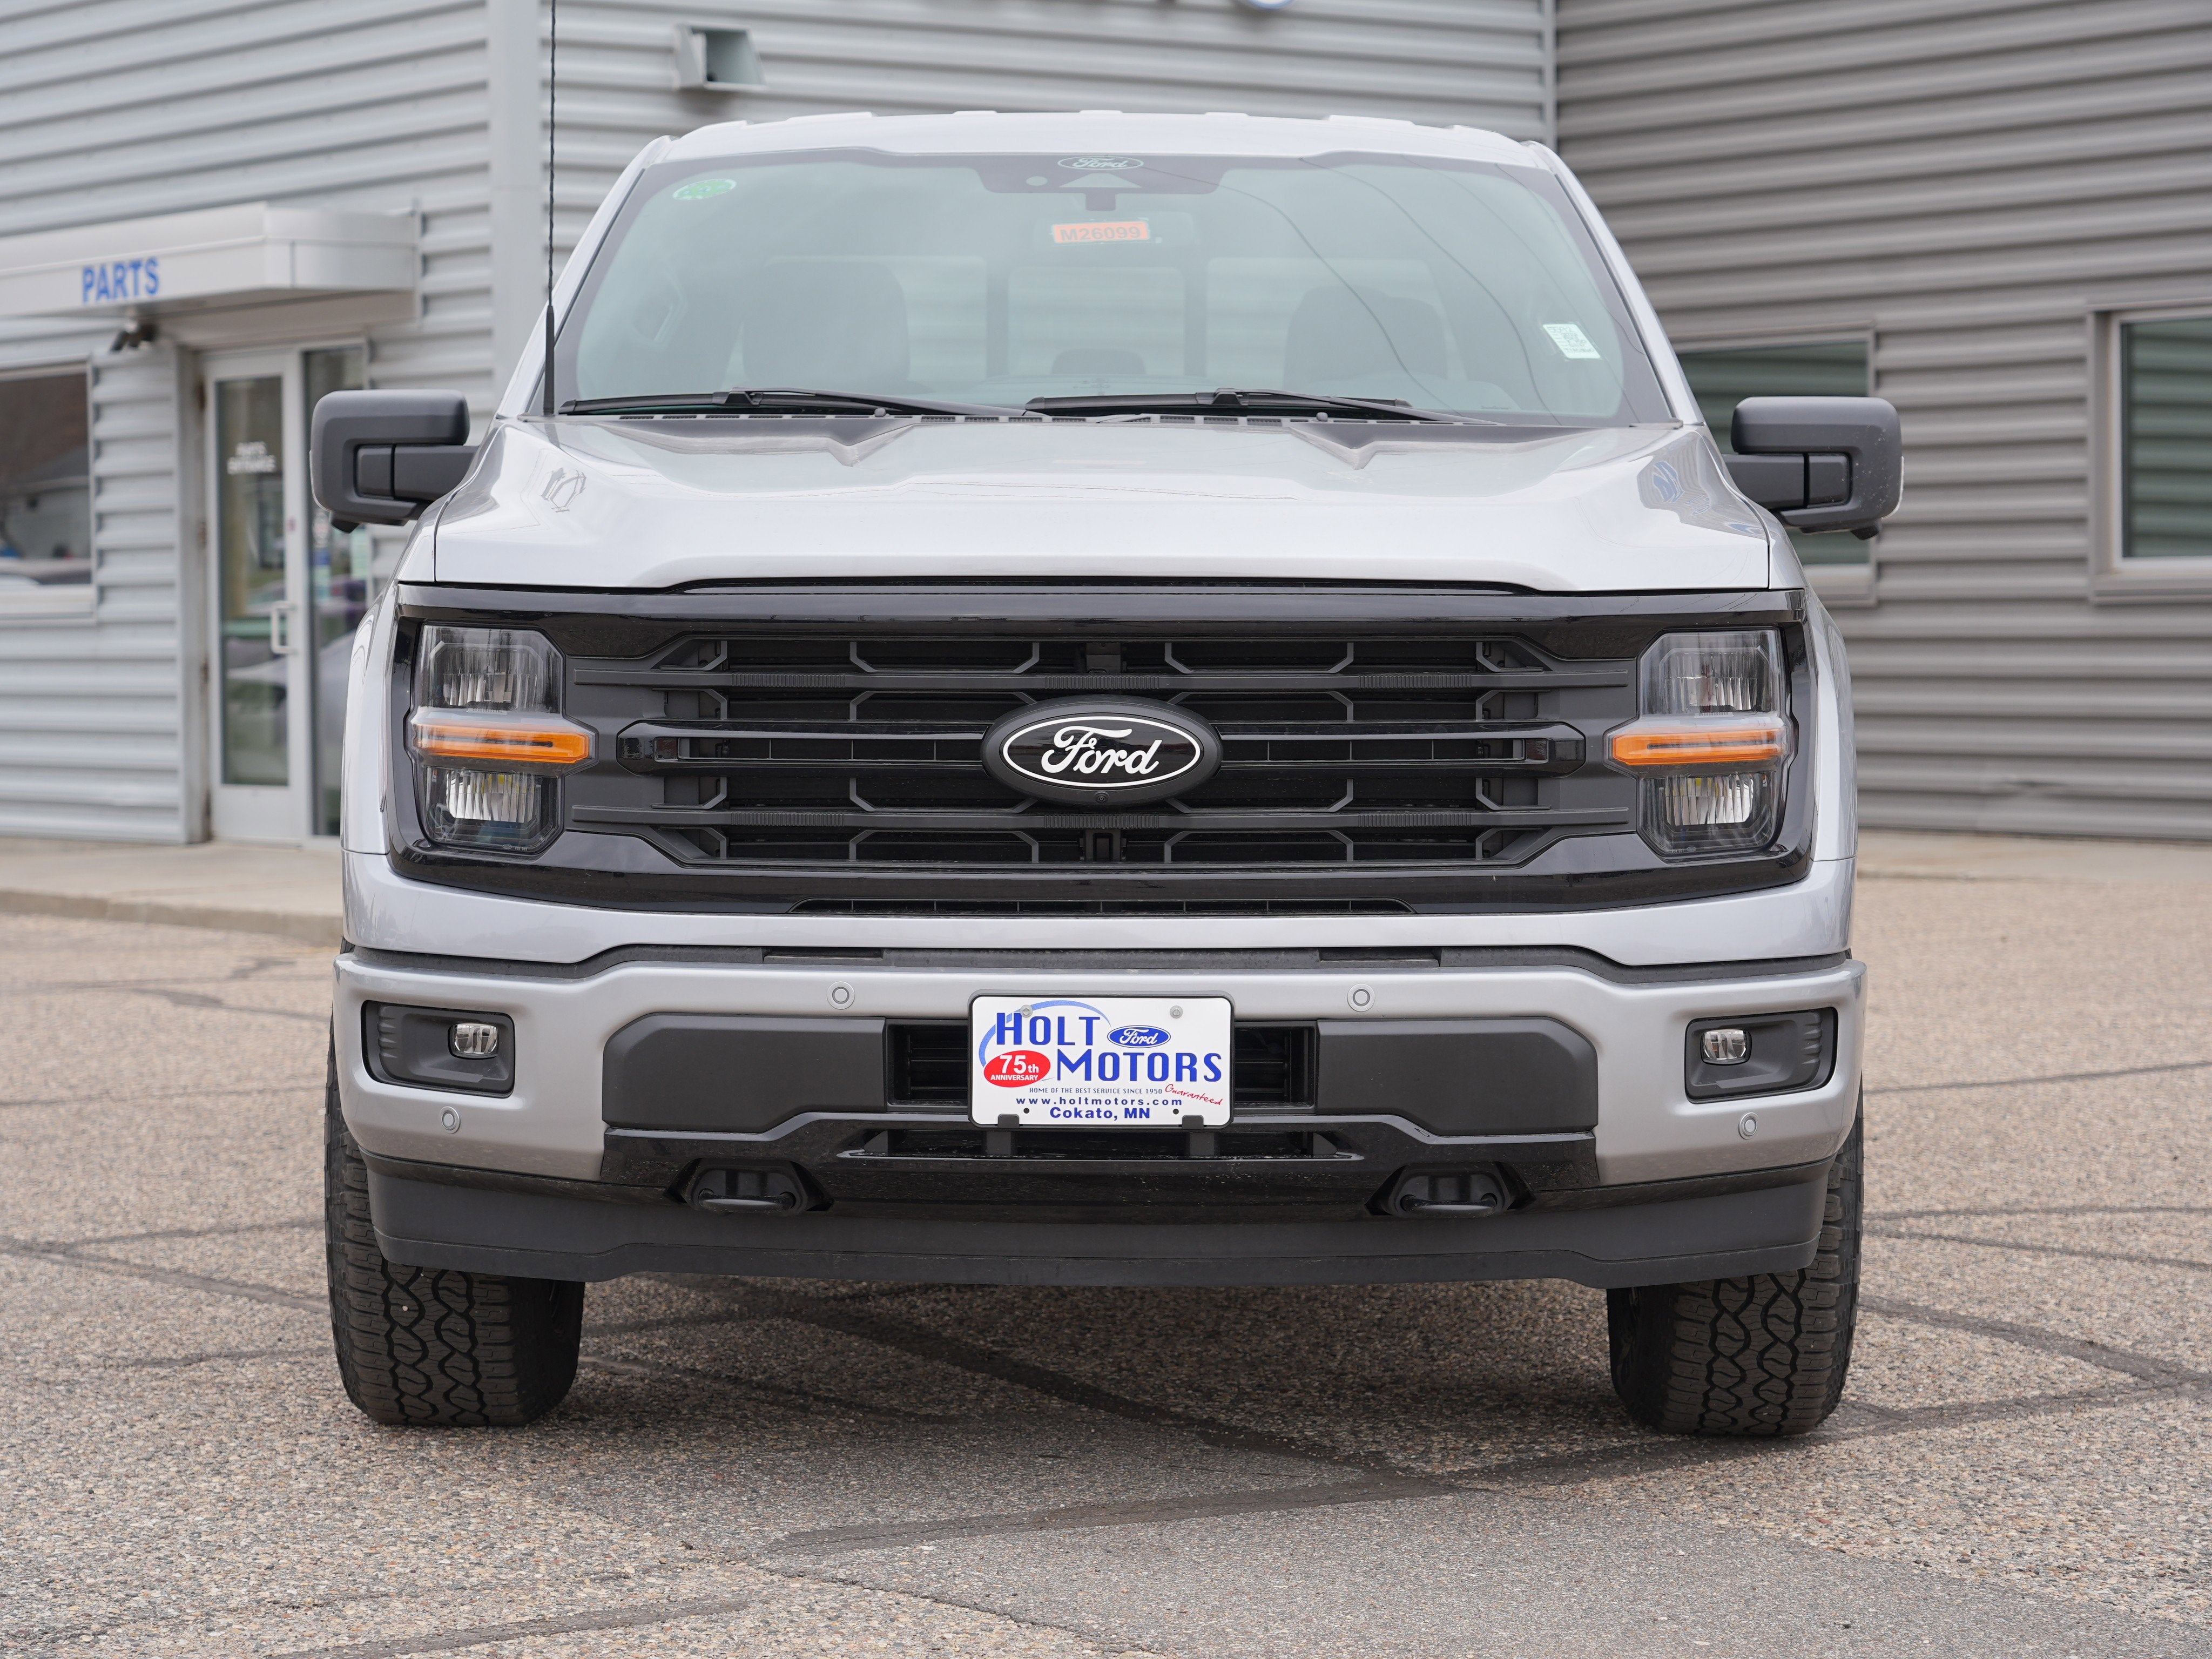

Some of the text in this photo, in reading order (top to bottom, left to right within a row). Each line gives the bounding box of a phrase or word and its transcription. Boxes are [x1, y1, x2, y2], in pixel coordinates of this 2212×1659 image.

[1072, 157, 1129, 168] Ford
[1060, 226, 1141, 241] M26099
[82, 256, 160, 304] PARTS
[1041, 725, 1163, 774] Ford
[996, 1012, 1100, 1046] HOLT
[1120, 1027, 1158, 1046] Ford
[999, 1055, 1039, 1074] 75th
[1057, 1048, 1222, 1082] MOTORS
[1016, 1097, 1182, 1105] www.holtmotors.com
[1165, 1083, 1223, 1105] Guaranteed
[1050, 1107, 1150, 1121] Cokato, MN
